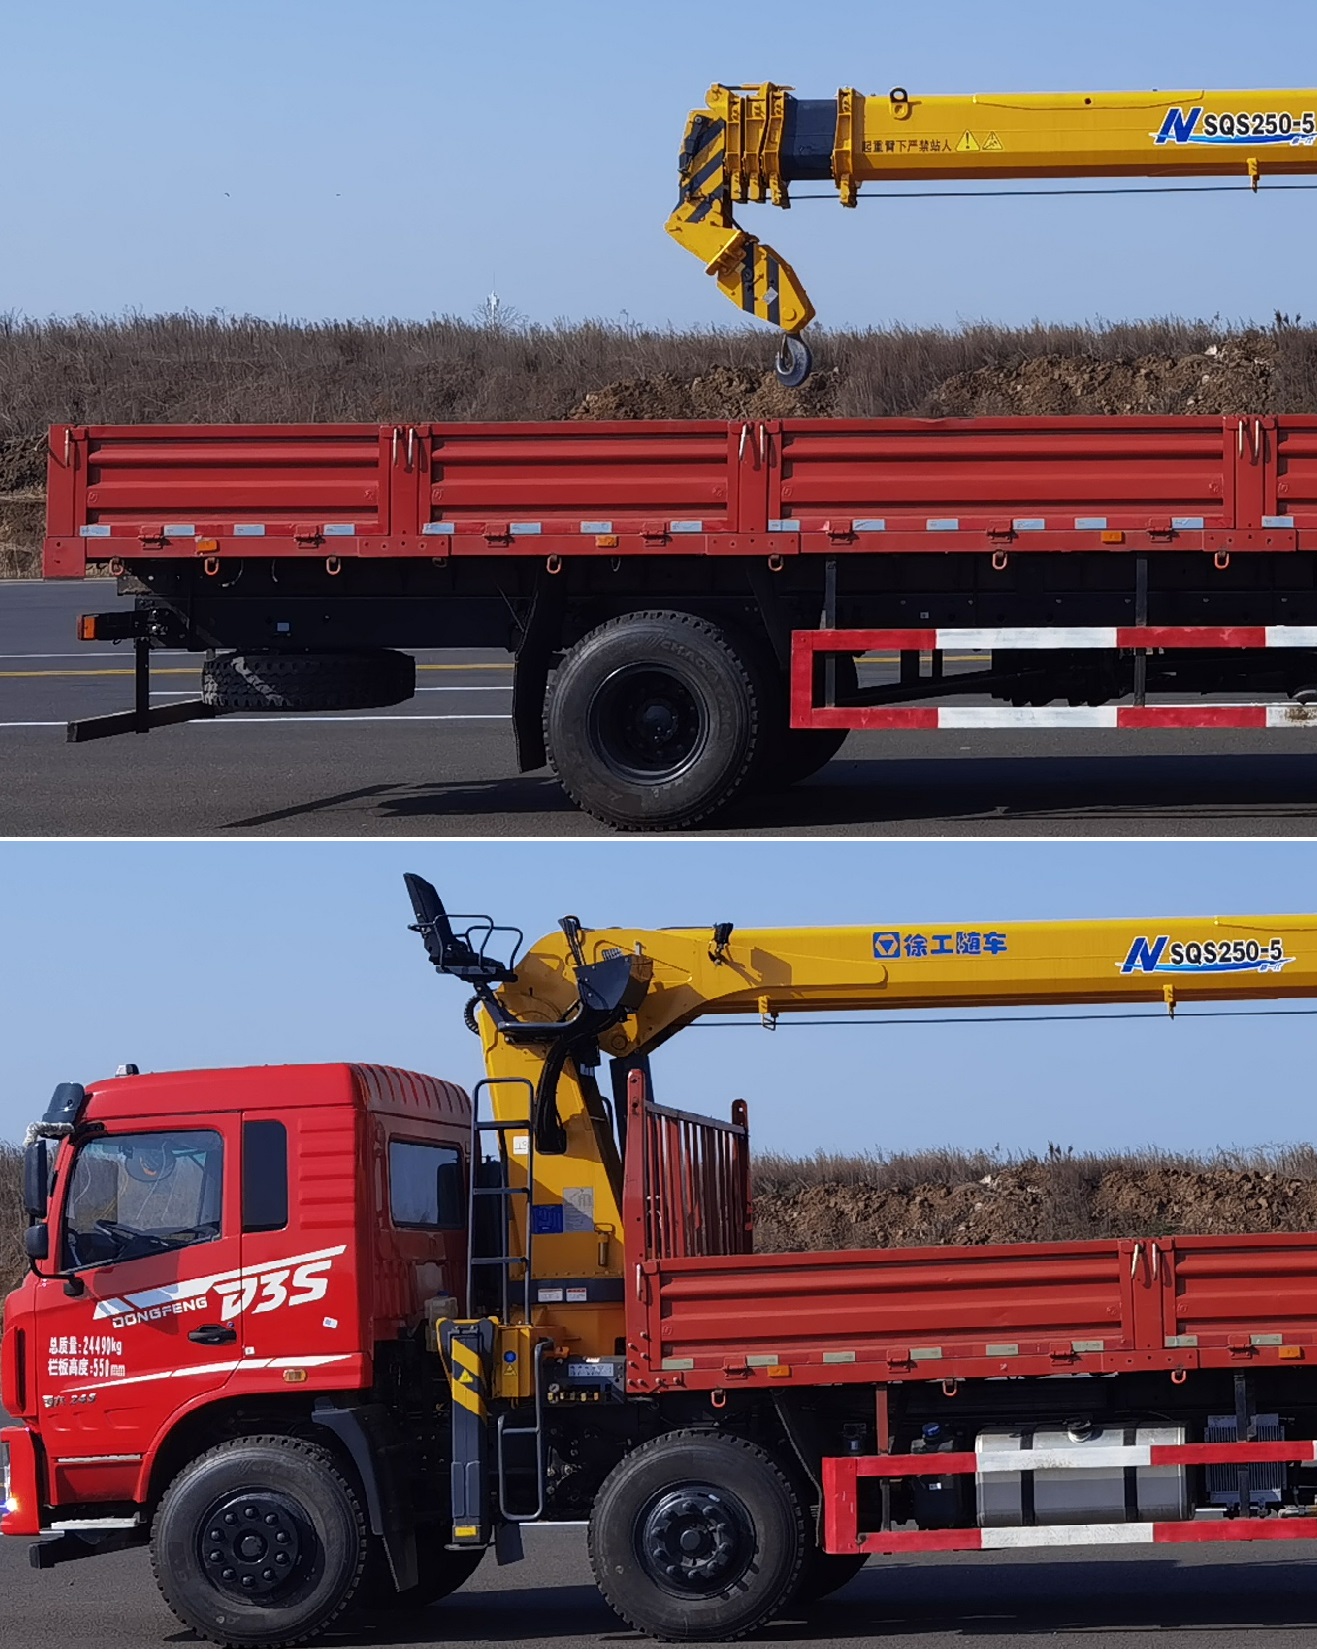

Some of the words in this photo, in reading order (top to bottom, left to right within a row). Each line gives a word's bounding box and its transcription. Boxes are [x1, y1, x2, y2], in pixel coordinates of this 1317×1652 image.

[1203, 112, 1315, 137] SQS250-5
[862, 139, 952, 152] 起重臂下严禁站人
[904, 932, 1007, 957] 徐工随车
[1170, 938, 1283, 966] SQS250-5
[212, 1260, 332, 1321] D3S
[112, 1296, 207, 1328] DONGFENG
